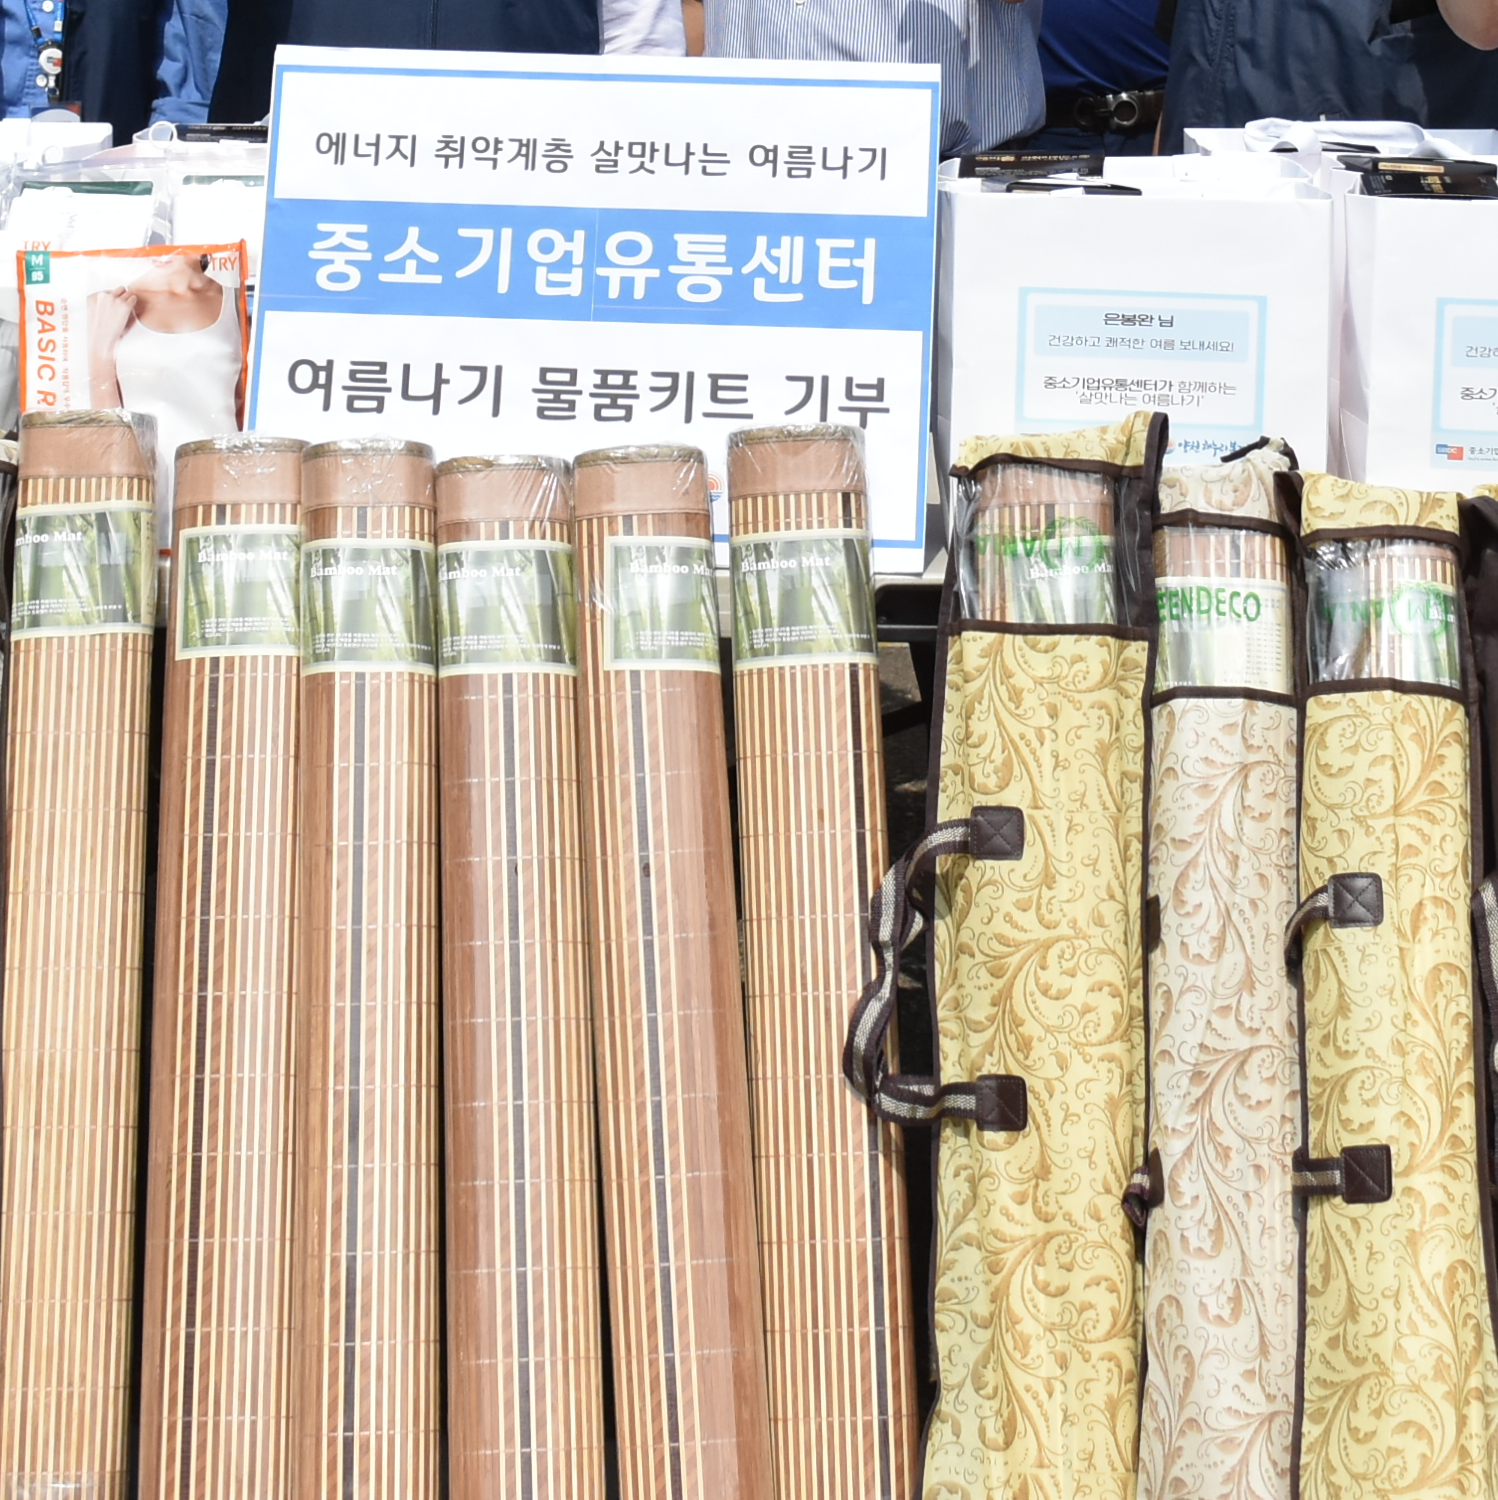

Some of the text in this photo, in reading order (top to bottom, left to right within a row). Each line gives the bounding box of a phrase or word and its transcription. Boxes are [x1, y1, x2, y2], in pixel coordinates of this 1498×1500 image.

[315, 131, 889, 182] 에너지 취약계층 살맛나는 여름나기
[32, 255, 43, 266] M
[210, 256, 238, 271] TRY
[306, 222, 877, 305] 중소기업유통센터
[31, 271, 44, 282] 95
[1159, 315, 1174, 327] 님
[1049, 335, 1234, 352] 건강하고 쾌적한 여름 보내세요!
[36, 300, 57, 407] BASIC R
[1043, 376, 1236, 395] 중소기업유통센터가 함께하는
[286, 358, 892, 430] 여름나기 물품키트 기부
[16, 530, 82, 546] mboo Mat
[198, 548, 288, 563] Bamboo Mat
[310, 563, 397, 579] Bamboo Mat
[491, 565, 521, 578] Mat
[629, 562, 689, 576] Bamboo
[741, 555, 830, 573] Bamboo Mat
[1157, 585, 1261, 622] EENDECO
